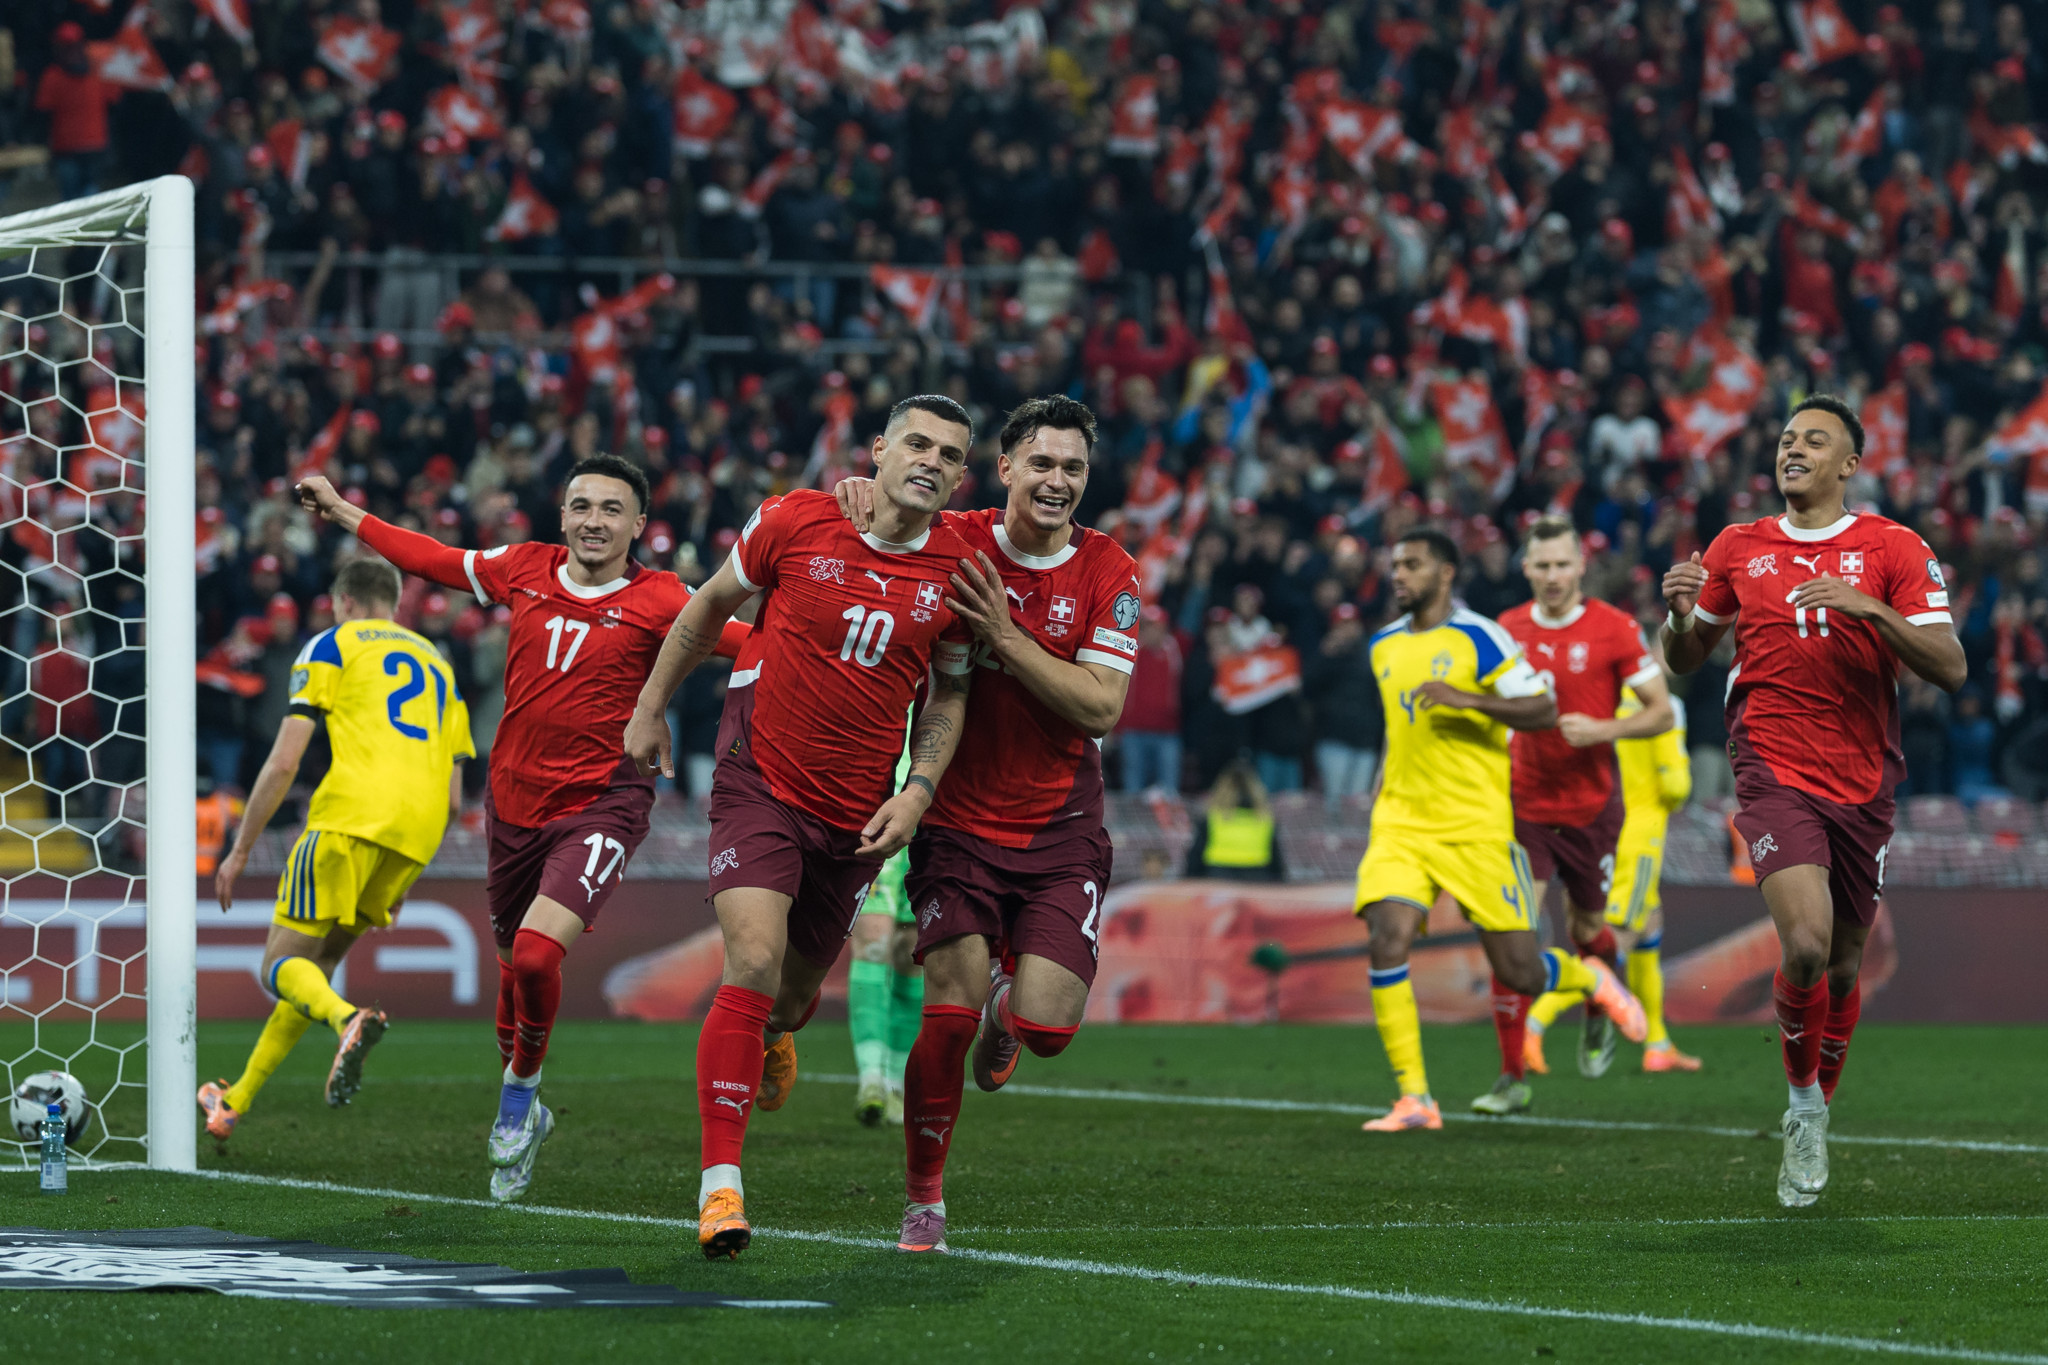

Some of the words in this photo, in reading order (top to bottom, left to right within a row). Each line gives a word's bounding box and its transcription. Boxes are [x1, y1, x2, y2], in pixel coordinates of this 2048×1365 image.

[545, 615, 591, 673] 17
[840, 604, 895, 667] 10
[383, 651, 446, 741] 21
[1400, 690, 1417, 725] 4
[584, 832, 625, 885] 17
[1502, 884, 1522, 918] 4
[712, 1080, 750, 1093] SUISSE
